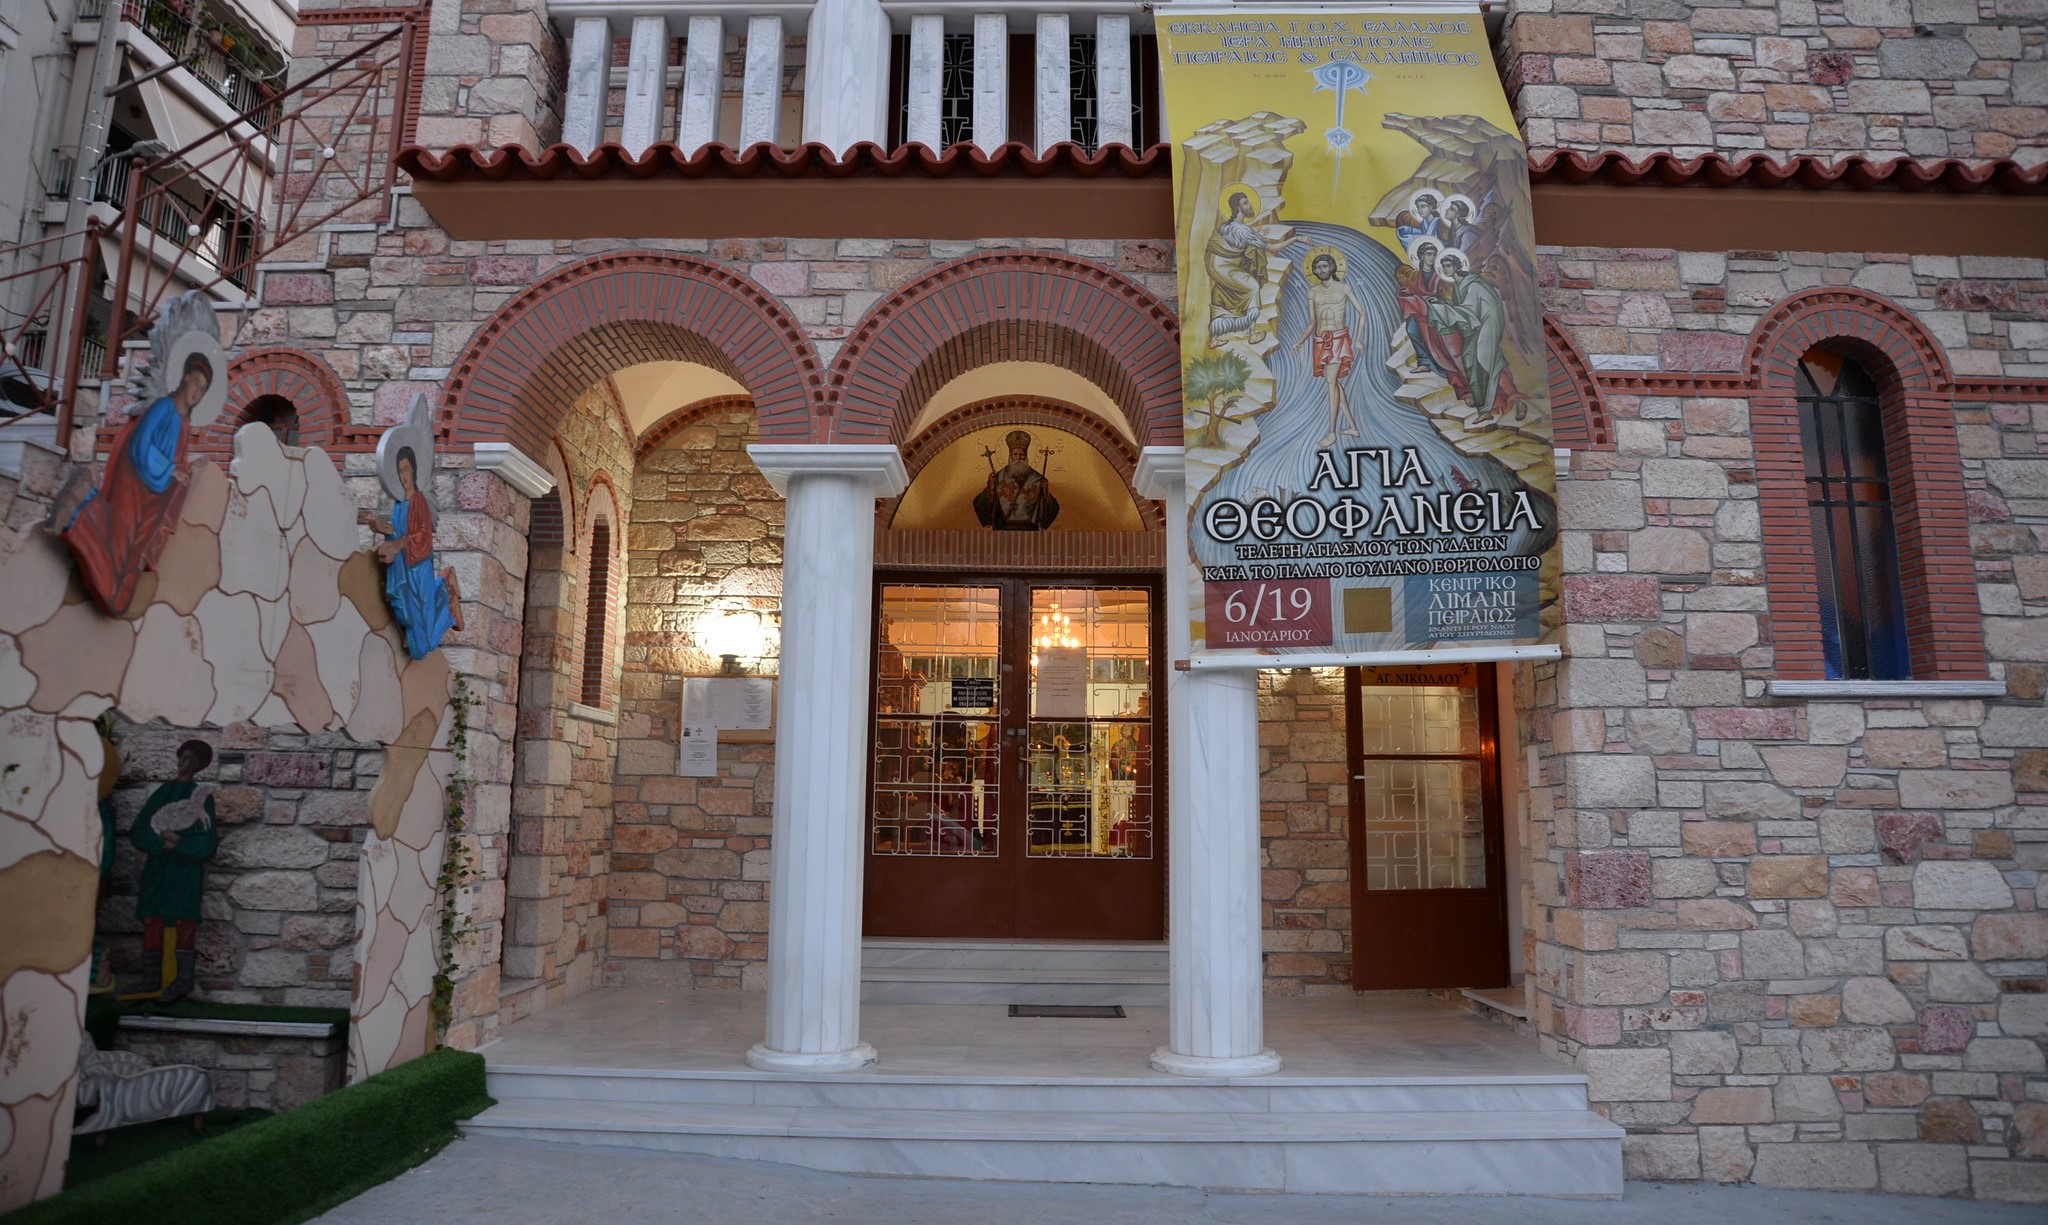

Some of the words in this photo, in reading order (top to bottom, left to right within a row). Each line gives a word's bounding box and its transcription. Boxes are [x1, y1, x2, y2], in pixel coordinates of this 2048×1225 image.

[1220, 35, 1272, 49] ΙΕΡΑ
[1297, 50, 1320, 64] &
[1309, 447, 1432, 490] ΑΓΙΑ
[1205, 491, 1543, 542] ΘΕΟΦΑΝΕΙΑ
[1236, 544, 1302, 560] ΤΕΛΕΤΗ
[1306, 541, 1393, 558] ΑΓΙΑΣΜΟΥ
[1396, 539, 1433, 554] ΤΩΝ
[1436, 536, 1508, 552] ΥΔΑΤΩΝ
[1204, 567, 1248, 581] ΚΑΤΑ
[1251, 565, 1275, 579] ΤΟ
[1278, 562, 1343, 579] ΠΑΛΑΙΟ
[1347, 559, 1431, 577] ΙΟΥΛΙΑΝΟ
[1433, 556, 1541, 574] ΕΟΡΤΟΛΟΓΙΟ
[1224, 583, 1312, 626] 6/19
[1428, 590, 1516, 609] ΛΙΜΑΝΙ
[1428, 607, 1516, 625] ΠΕΙΡΑΙΩΣ
[1226, 629, 1312, 643] ΙΑΝΟΥΑΡΙΟΥ
[1395, 673, 1462, 684] ΝΙΚΟΛΑΟΥ
